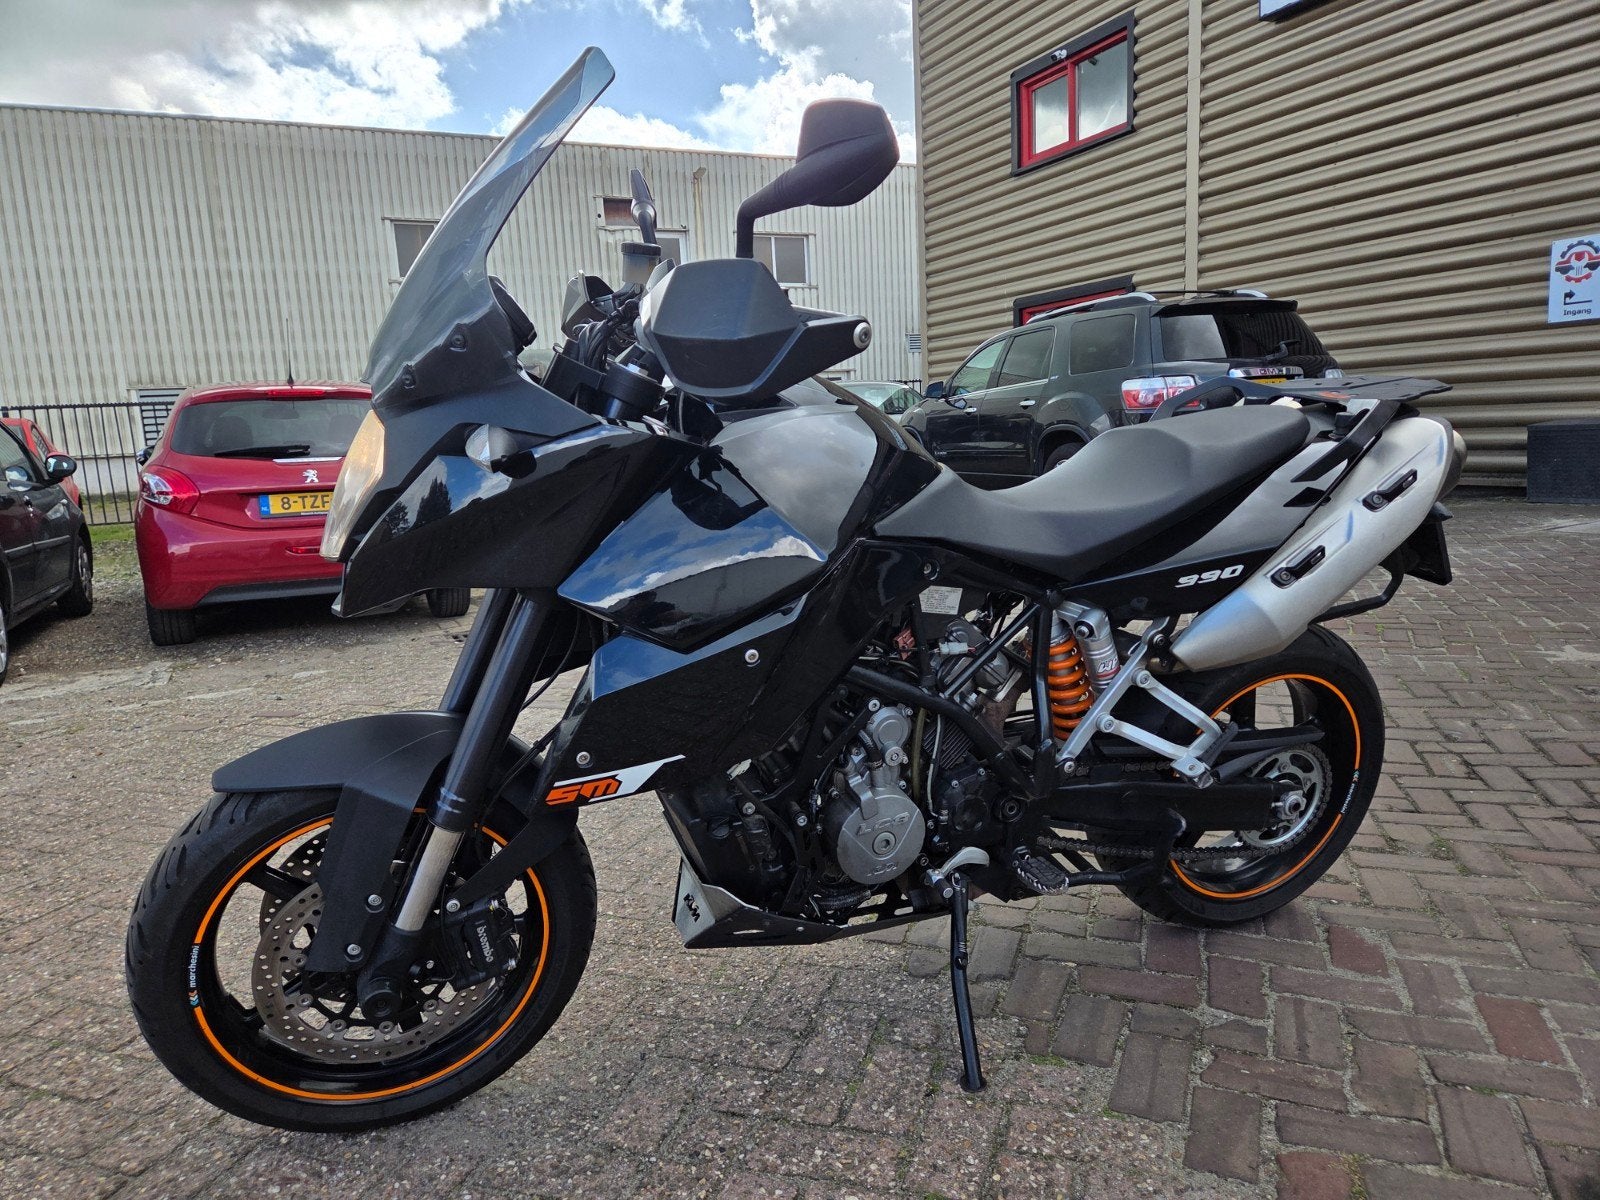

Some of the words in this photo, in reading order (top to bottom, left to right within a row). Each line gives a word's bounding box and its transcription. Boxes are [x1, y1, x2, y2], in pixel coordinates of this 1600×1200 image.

[1563, 308, 1592, 316] Ingang
[1174, 564, 1245, 588] 990
[476, 925, 494, 963] brembo
[188, 945, 200, 988] marchesini
